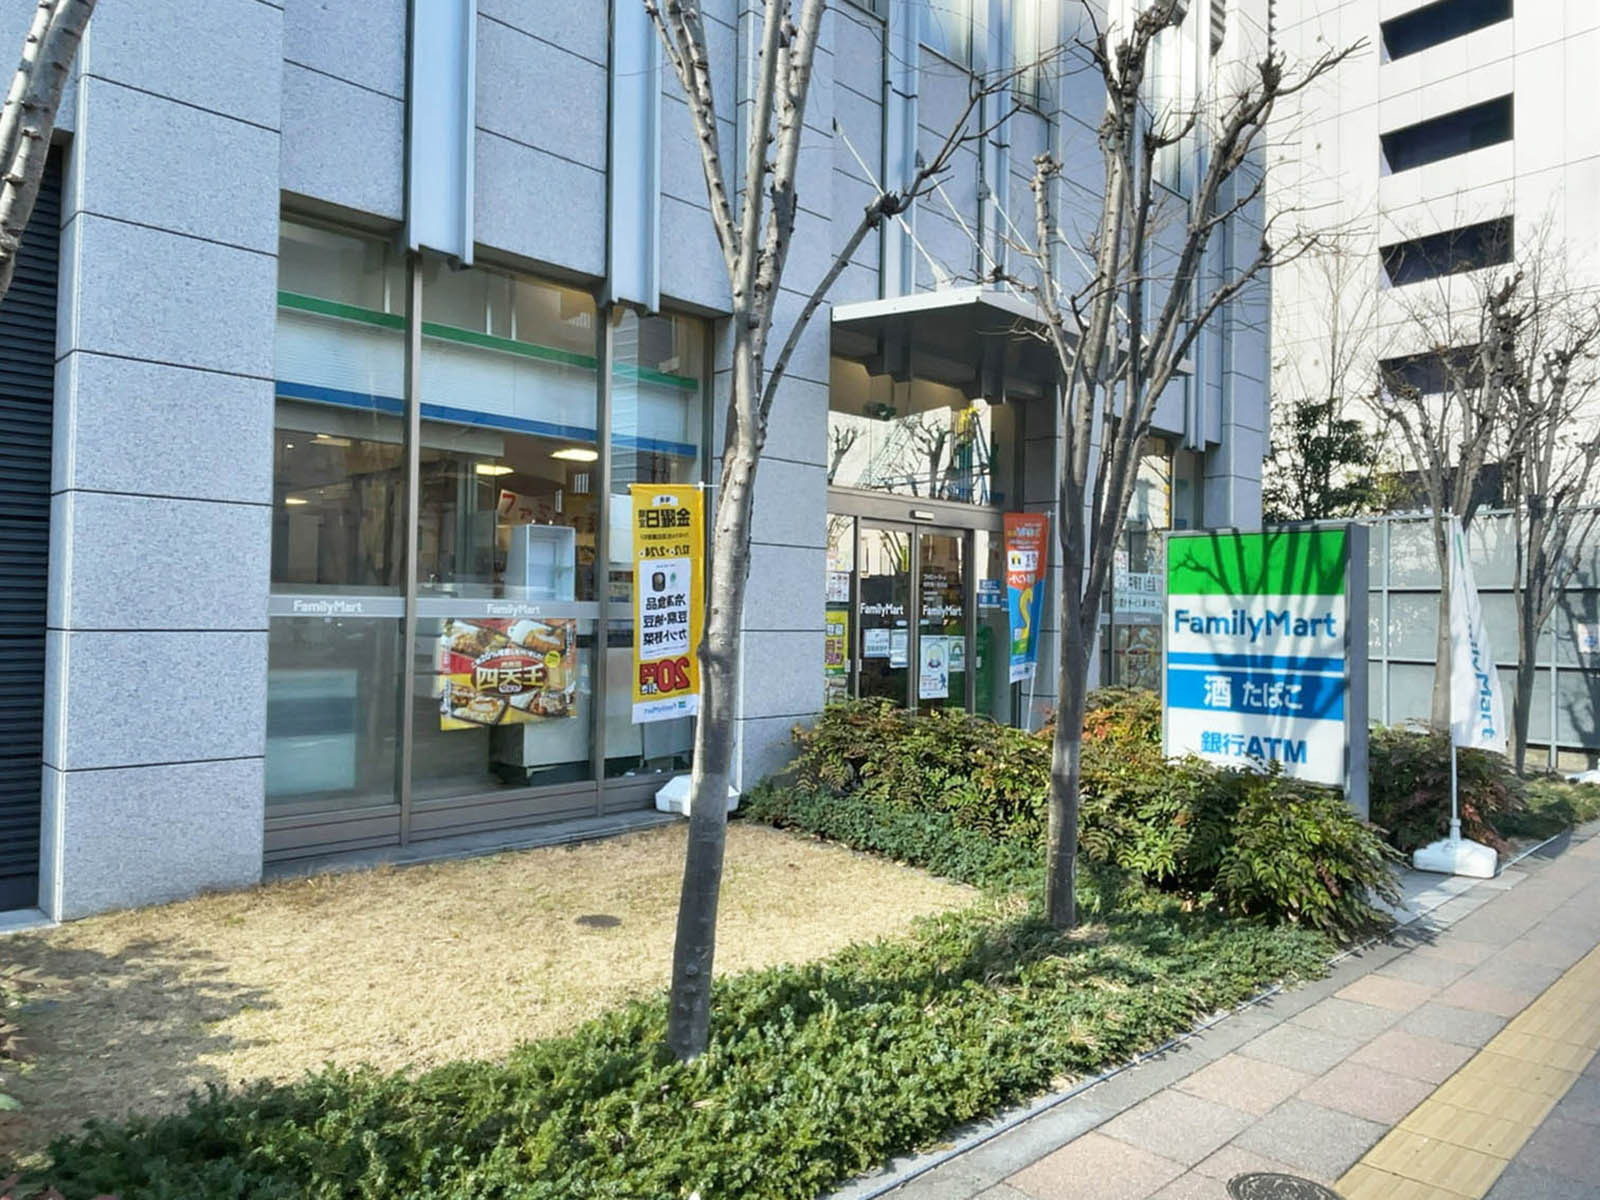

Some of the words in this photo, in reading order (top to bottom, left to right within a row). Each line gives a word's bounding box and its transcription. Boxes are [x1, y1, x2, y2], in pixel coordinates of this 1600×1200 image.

[293, 599, 362, 615] FamilyMart
[486, 602, 541, 617] FamilyMart
[859, 602, 904, 618] FamilyMart
[922, 605, 963, 617] FamilyMart
[1174, 608, 1337, 643] FamilyMart
[476, 663, 545, 692] 四天王
[1204, 676, 1232, 708] 酒
[1242, 681, 1303, 710] たばこ
[1200, 730, 1308, 765] 銀行ATM
